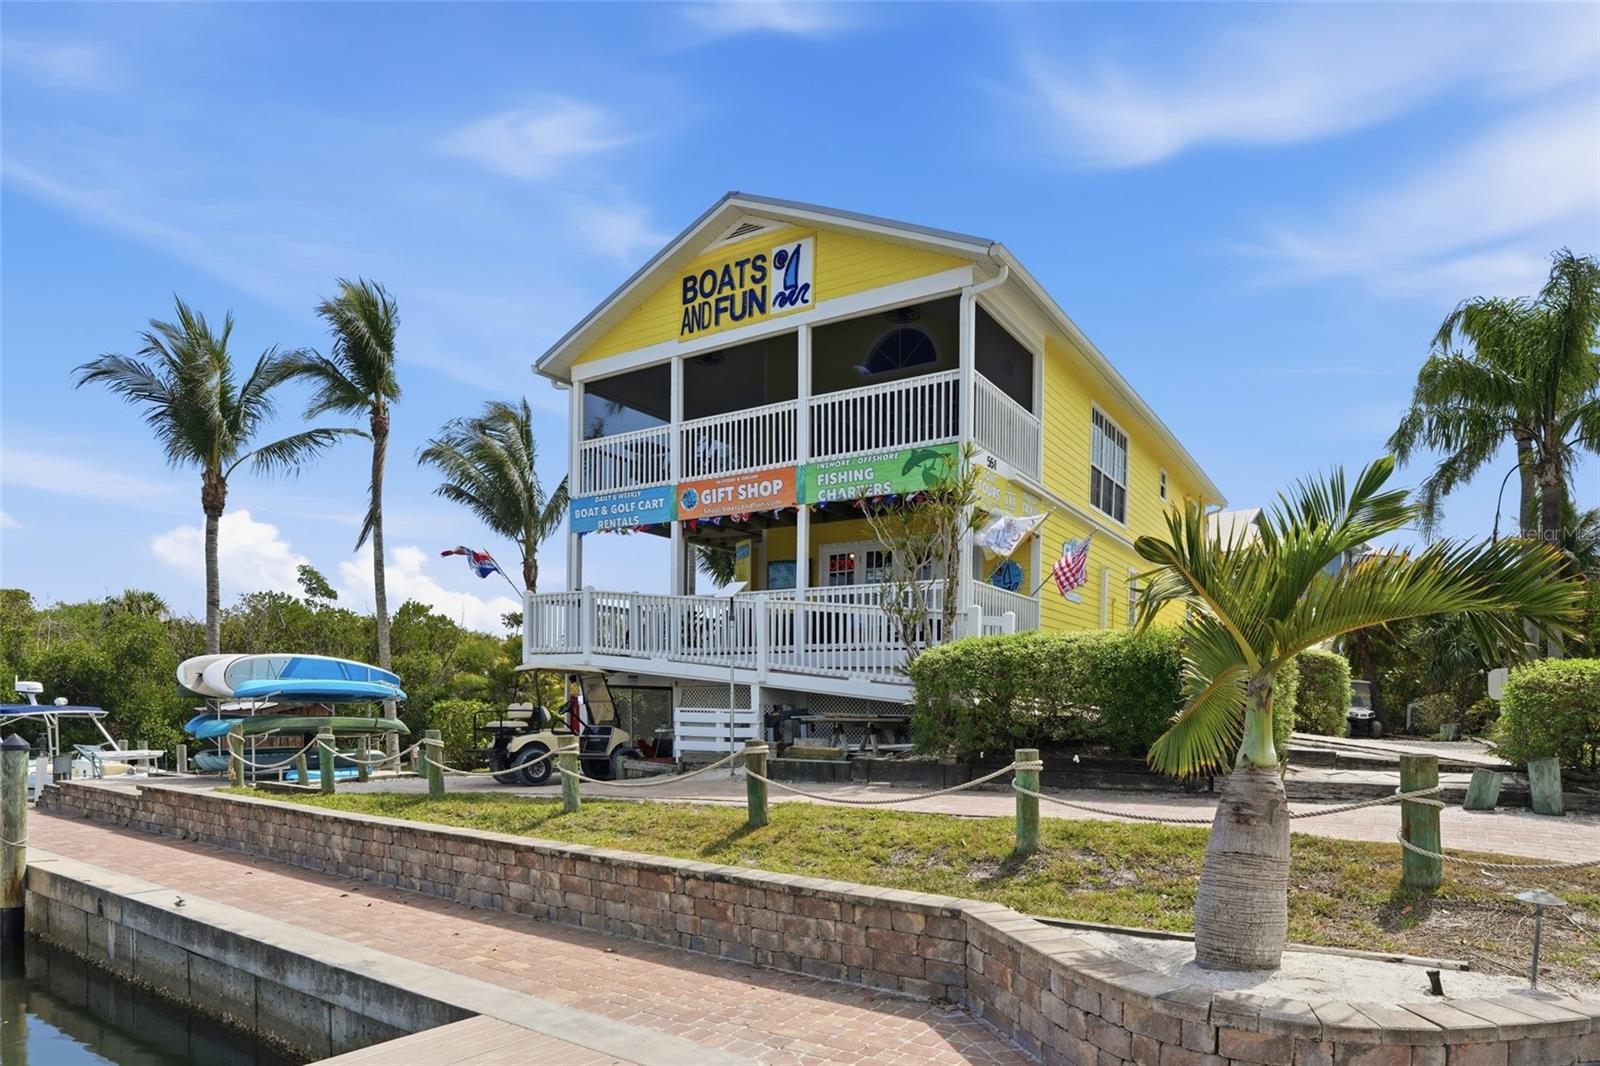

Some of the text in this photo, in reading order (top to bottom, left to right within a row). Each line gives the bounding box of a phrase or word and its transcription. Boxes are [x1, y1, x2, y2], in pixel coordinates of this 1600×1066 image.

[682, 254, 768, 305] BOATS
[680, 285, 767, 336] AND FUN
[816, 459, 850, 470] INSHORE
[857, 452, 899, 465] OFFSHORE
[817, 467, 875, 486] FISHING
[701, 479, 784, 505] GIFT SHOP
[817, 481, 892, 503] CHARTERS
[574, 497, 665, 519] BOAT & GOLF CART
[597, 515, 640, 530] RENTALS
